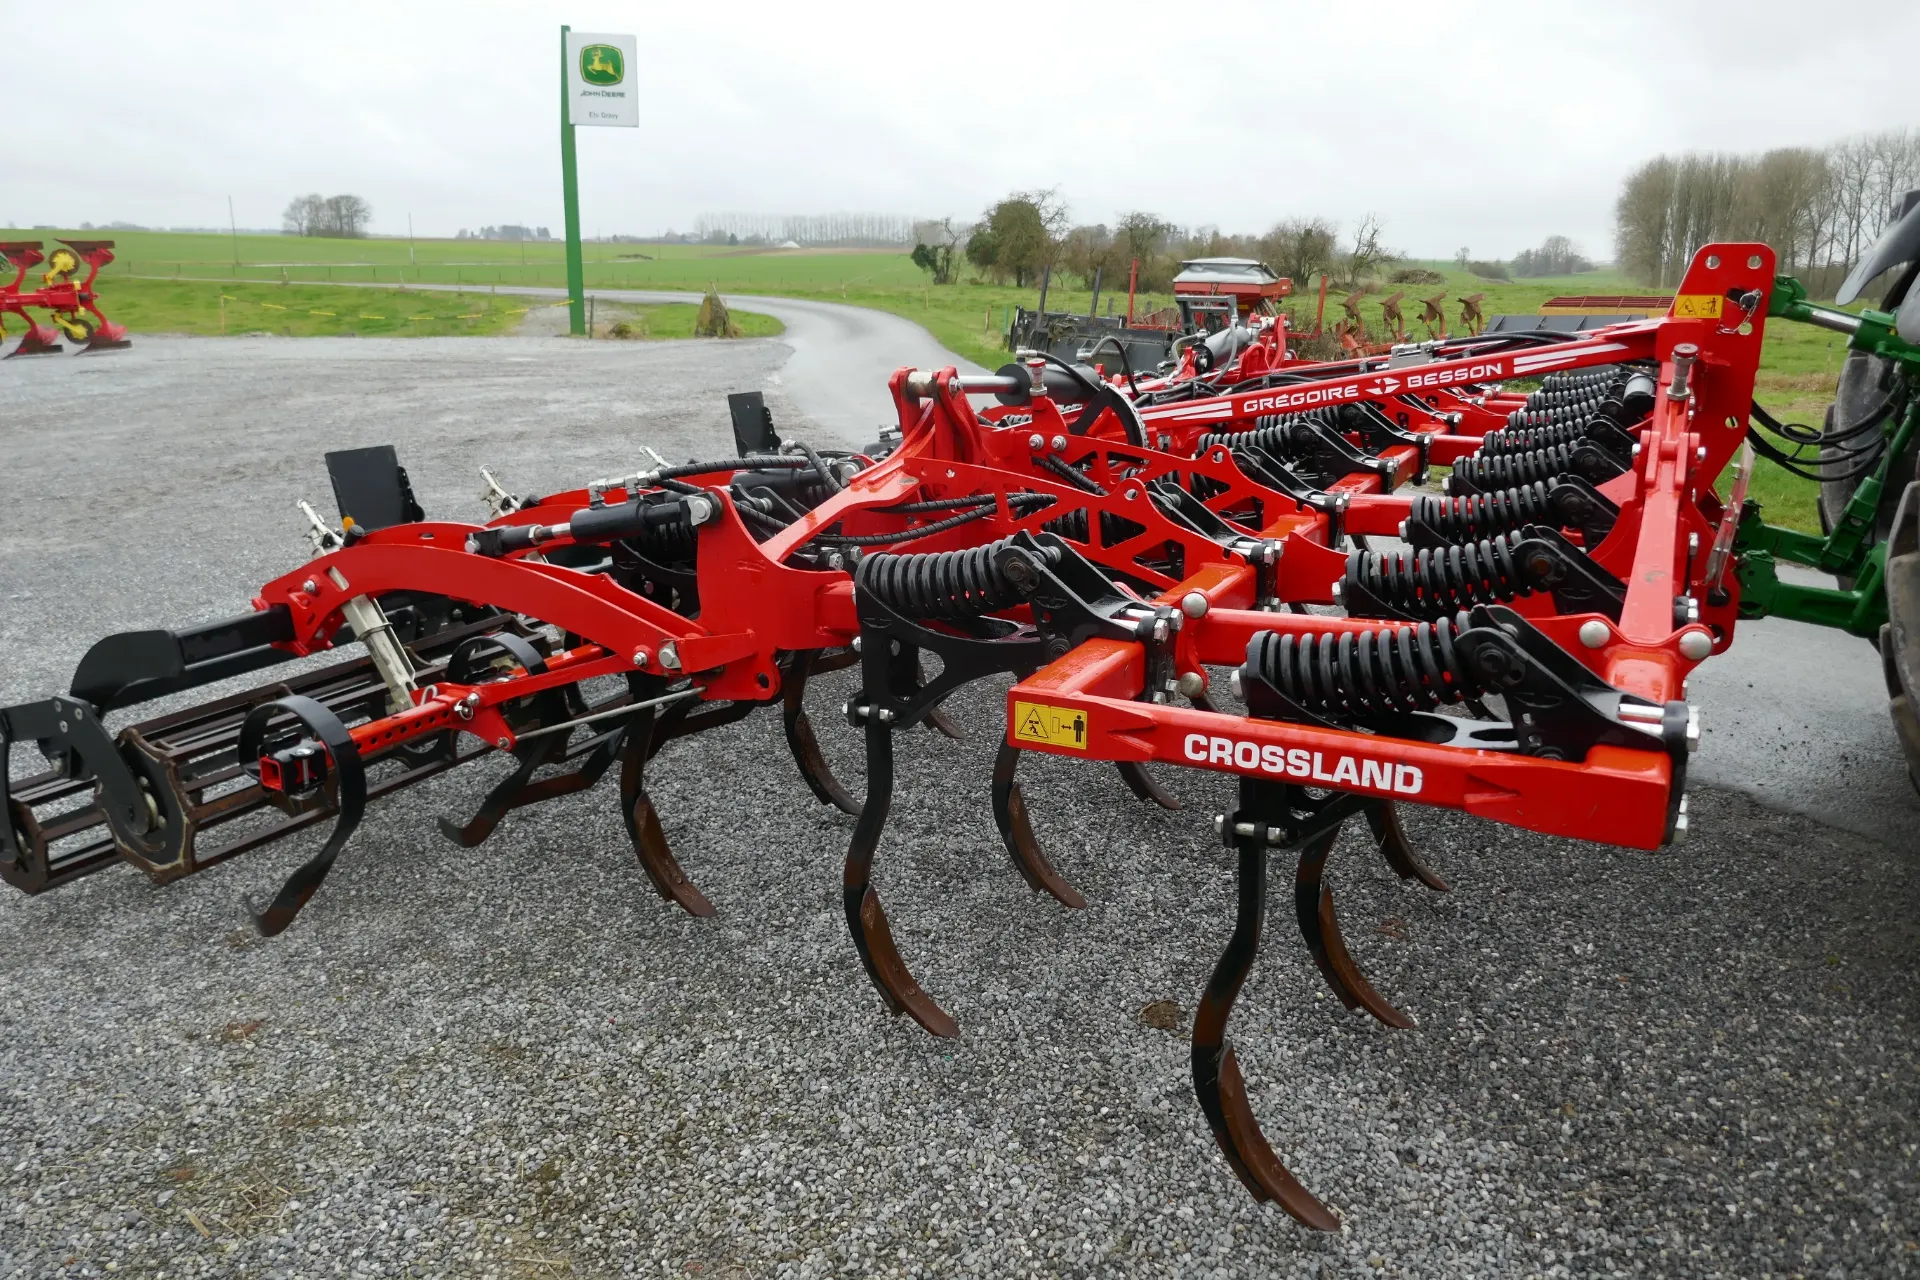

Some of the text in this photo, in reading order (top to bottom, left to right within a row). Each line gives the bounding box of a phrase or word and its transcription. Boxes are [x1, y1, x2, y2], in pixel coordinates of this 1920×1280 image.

[1243, 362, 1503, 413] GRÉGOIRE BESSON
[1184, 733, 1423, 795] CROSSLAND
